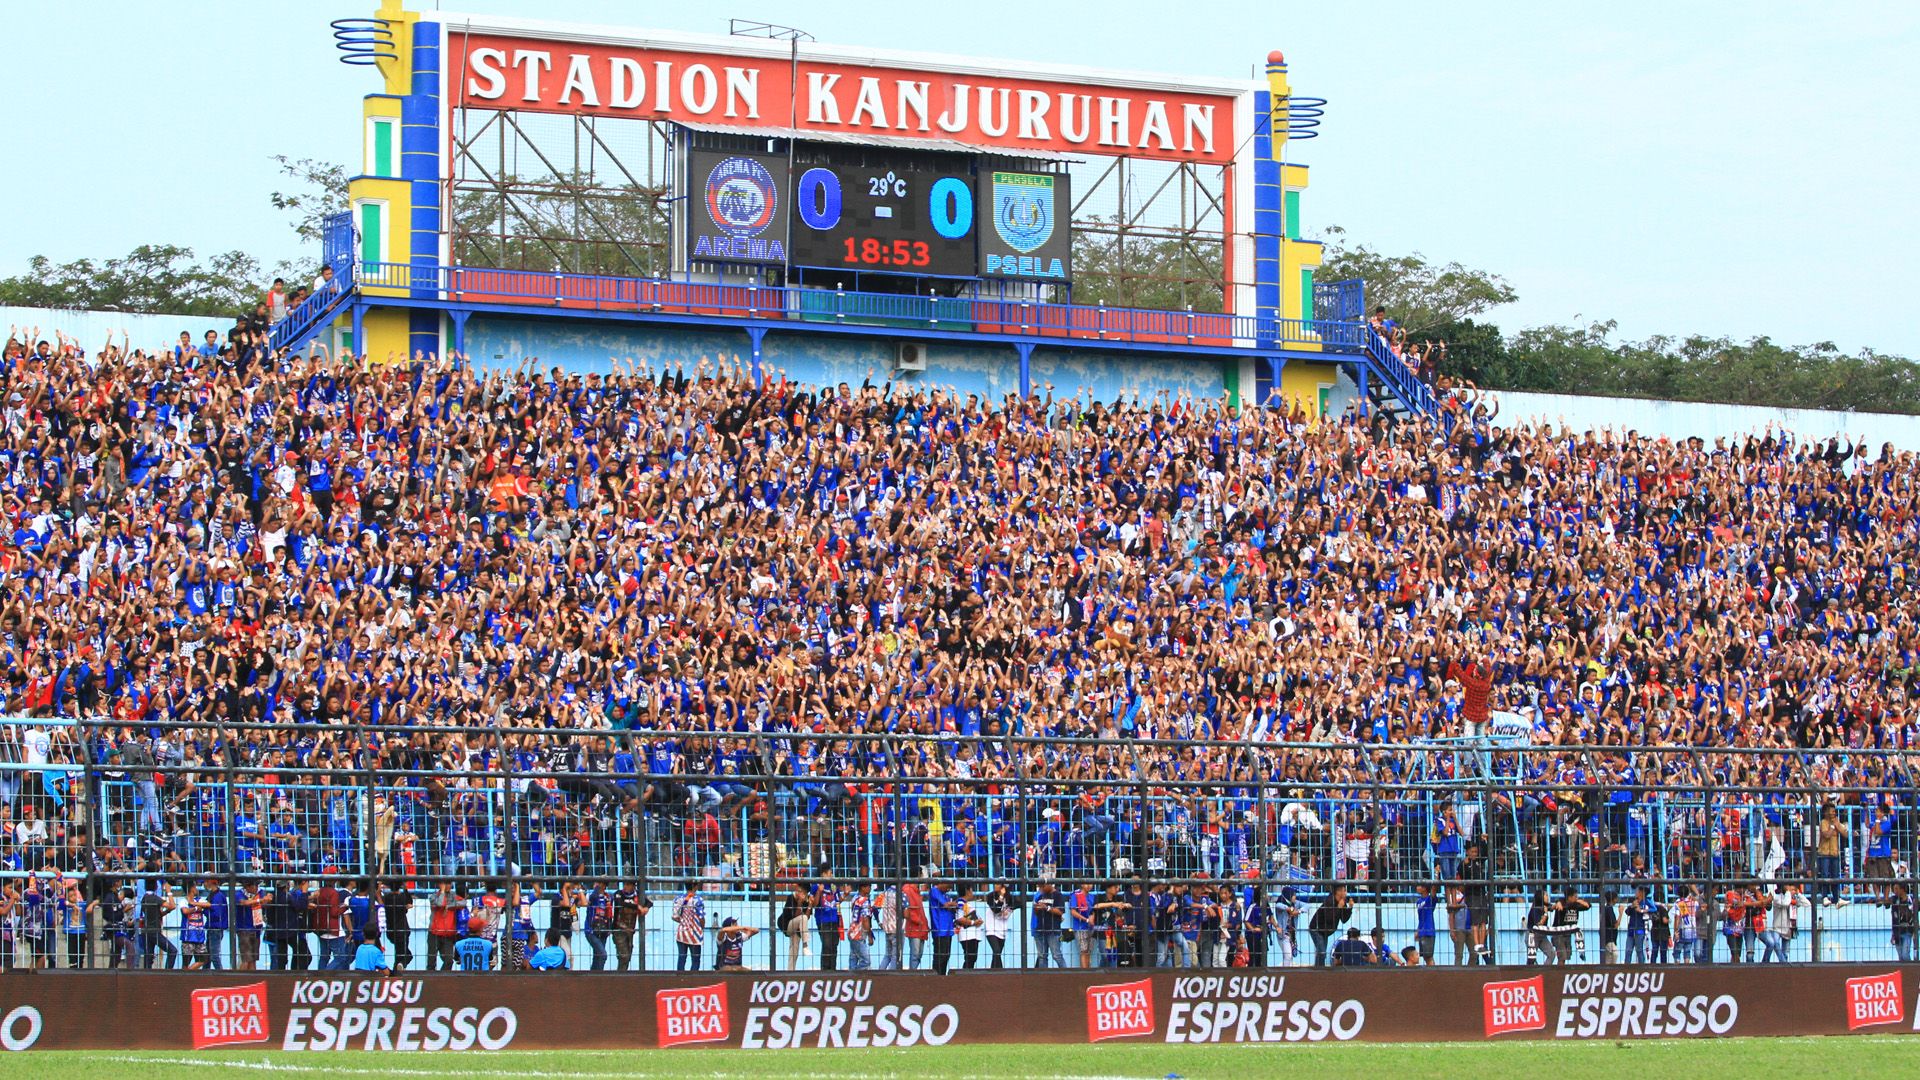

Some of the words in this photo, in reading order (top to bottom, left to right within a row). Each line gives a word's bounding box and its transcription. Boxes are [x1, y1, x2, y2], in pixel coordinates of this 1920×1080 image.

[467, 47, 761, 119] STADION
[806, 72, 1216, 153] KANJURUHAN
[717, 160, 750, 180] AREMA
[1000, 174, 1047, 187] PERSELA
[798, 167, 842, 231] 0
[929, 176, 973, 240] 0
[693, 235, 787, 261] AREMA
[843, 237, 931, 267] 18:53
[986, 253, 1066, 278] PSELA
[291, 980, 351, 1004] KOPI
[356, 979, 423, 1004] SUSU
[749, 980, 806, 1003] KOPI
[809, 980, 873, 1002] SUSU
[1172, 976, 1224, 999] KOPI
[1227, 976, 1286, 998] SUSU
[1562, 973, 1609, 994] KOPI
[1612, 972, 1665, 994] SUSU
[1850, 980, 1897, 1003] TORA
[198, 994, 261, 1016] TORA
[662, 994, 722, 1016] TORA
[1092, 989, 1147, 1011] TORA
[1487, 984, 1539, 1006] TORA
[1097, 1009, 1147, 1031] BIKA
[1165, 999, 1366, 1043] ESPRESSO
[1492, 1005, 1539, 1026] BIKA
[1555, 994, 1739, 1037] ESPRESSO
[1854, 1000, 1898, 1023] BIKA
[203, 1014, 262, 1037] BIKA
[282, 1006, 518, 1052] ESPRESSO
[667, 1013, 722, 1036] BIKA
[740, 1003, 960, 1049] ESPRESSO
